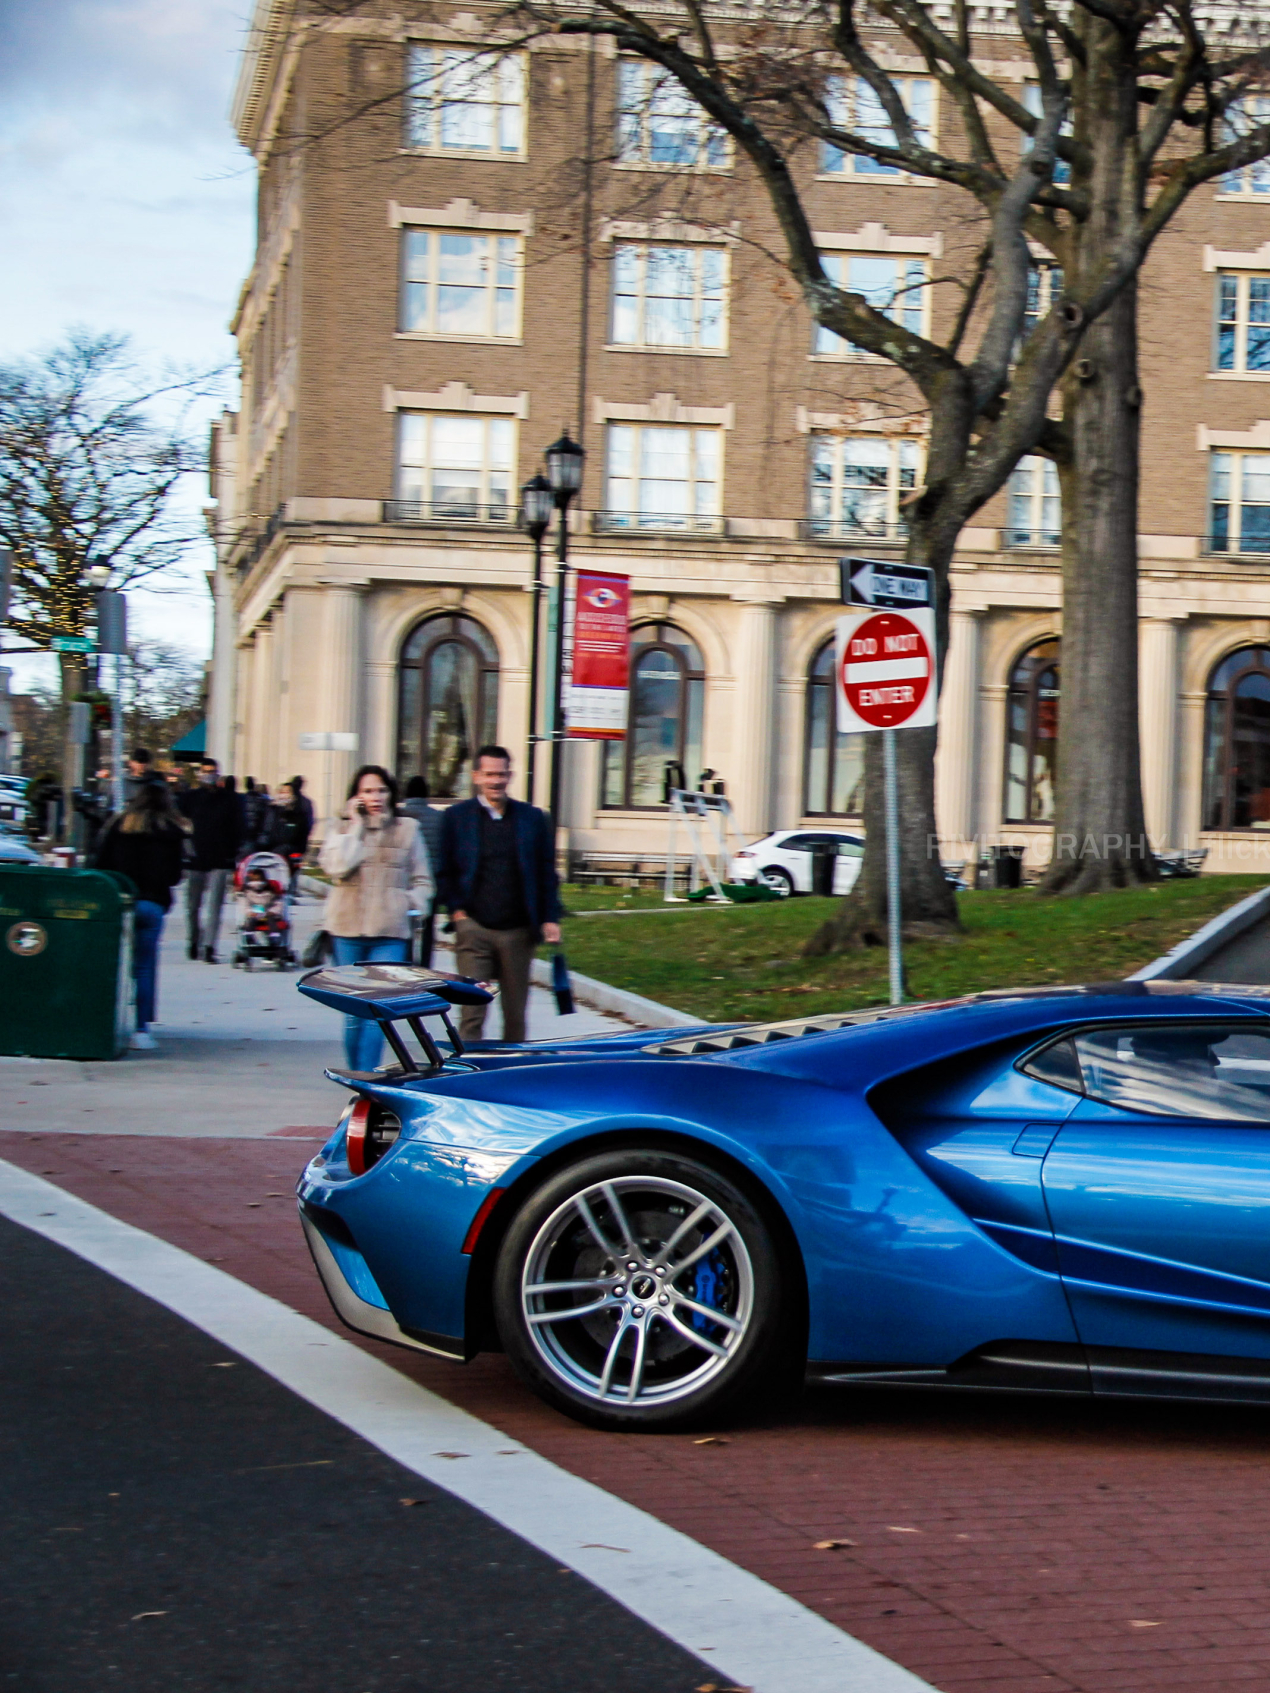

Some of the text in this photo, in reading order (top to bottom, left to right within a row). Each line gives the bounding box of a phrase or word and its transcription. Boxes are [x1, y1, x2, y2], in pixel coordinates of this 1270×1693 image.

[851, 634, 919, 656] DO NOT
[858, 685, 915, 706] ENTER
